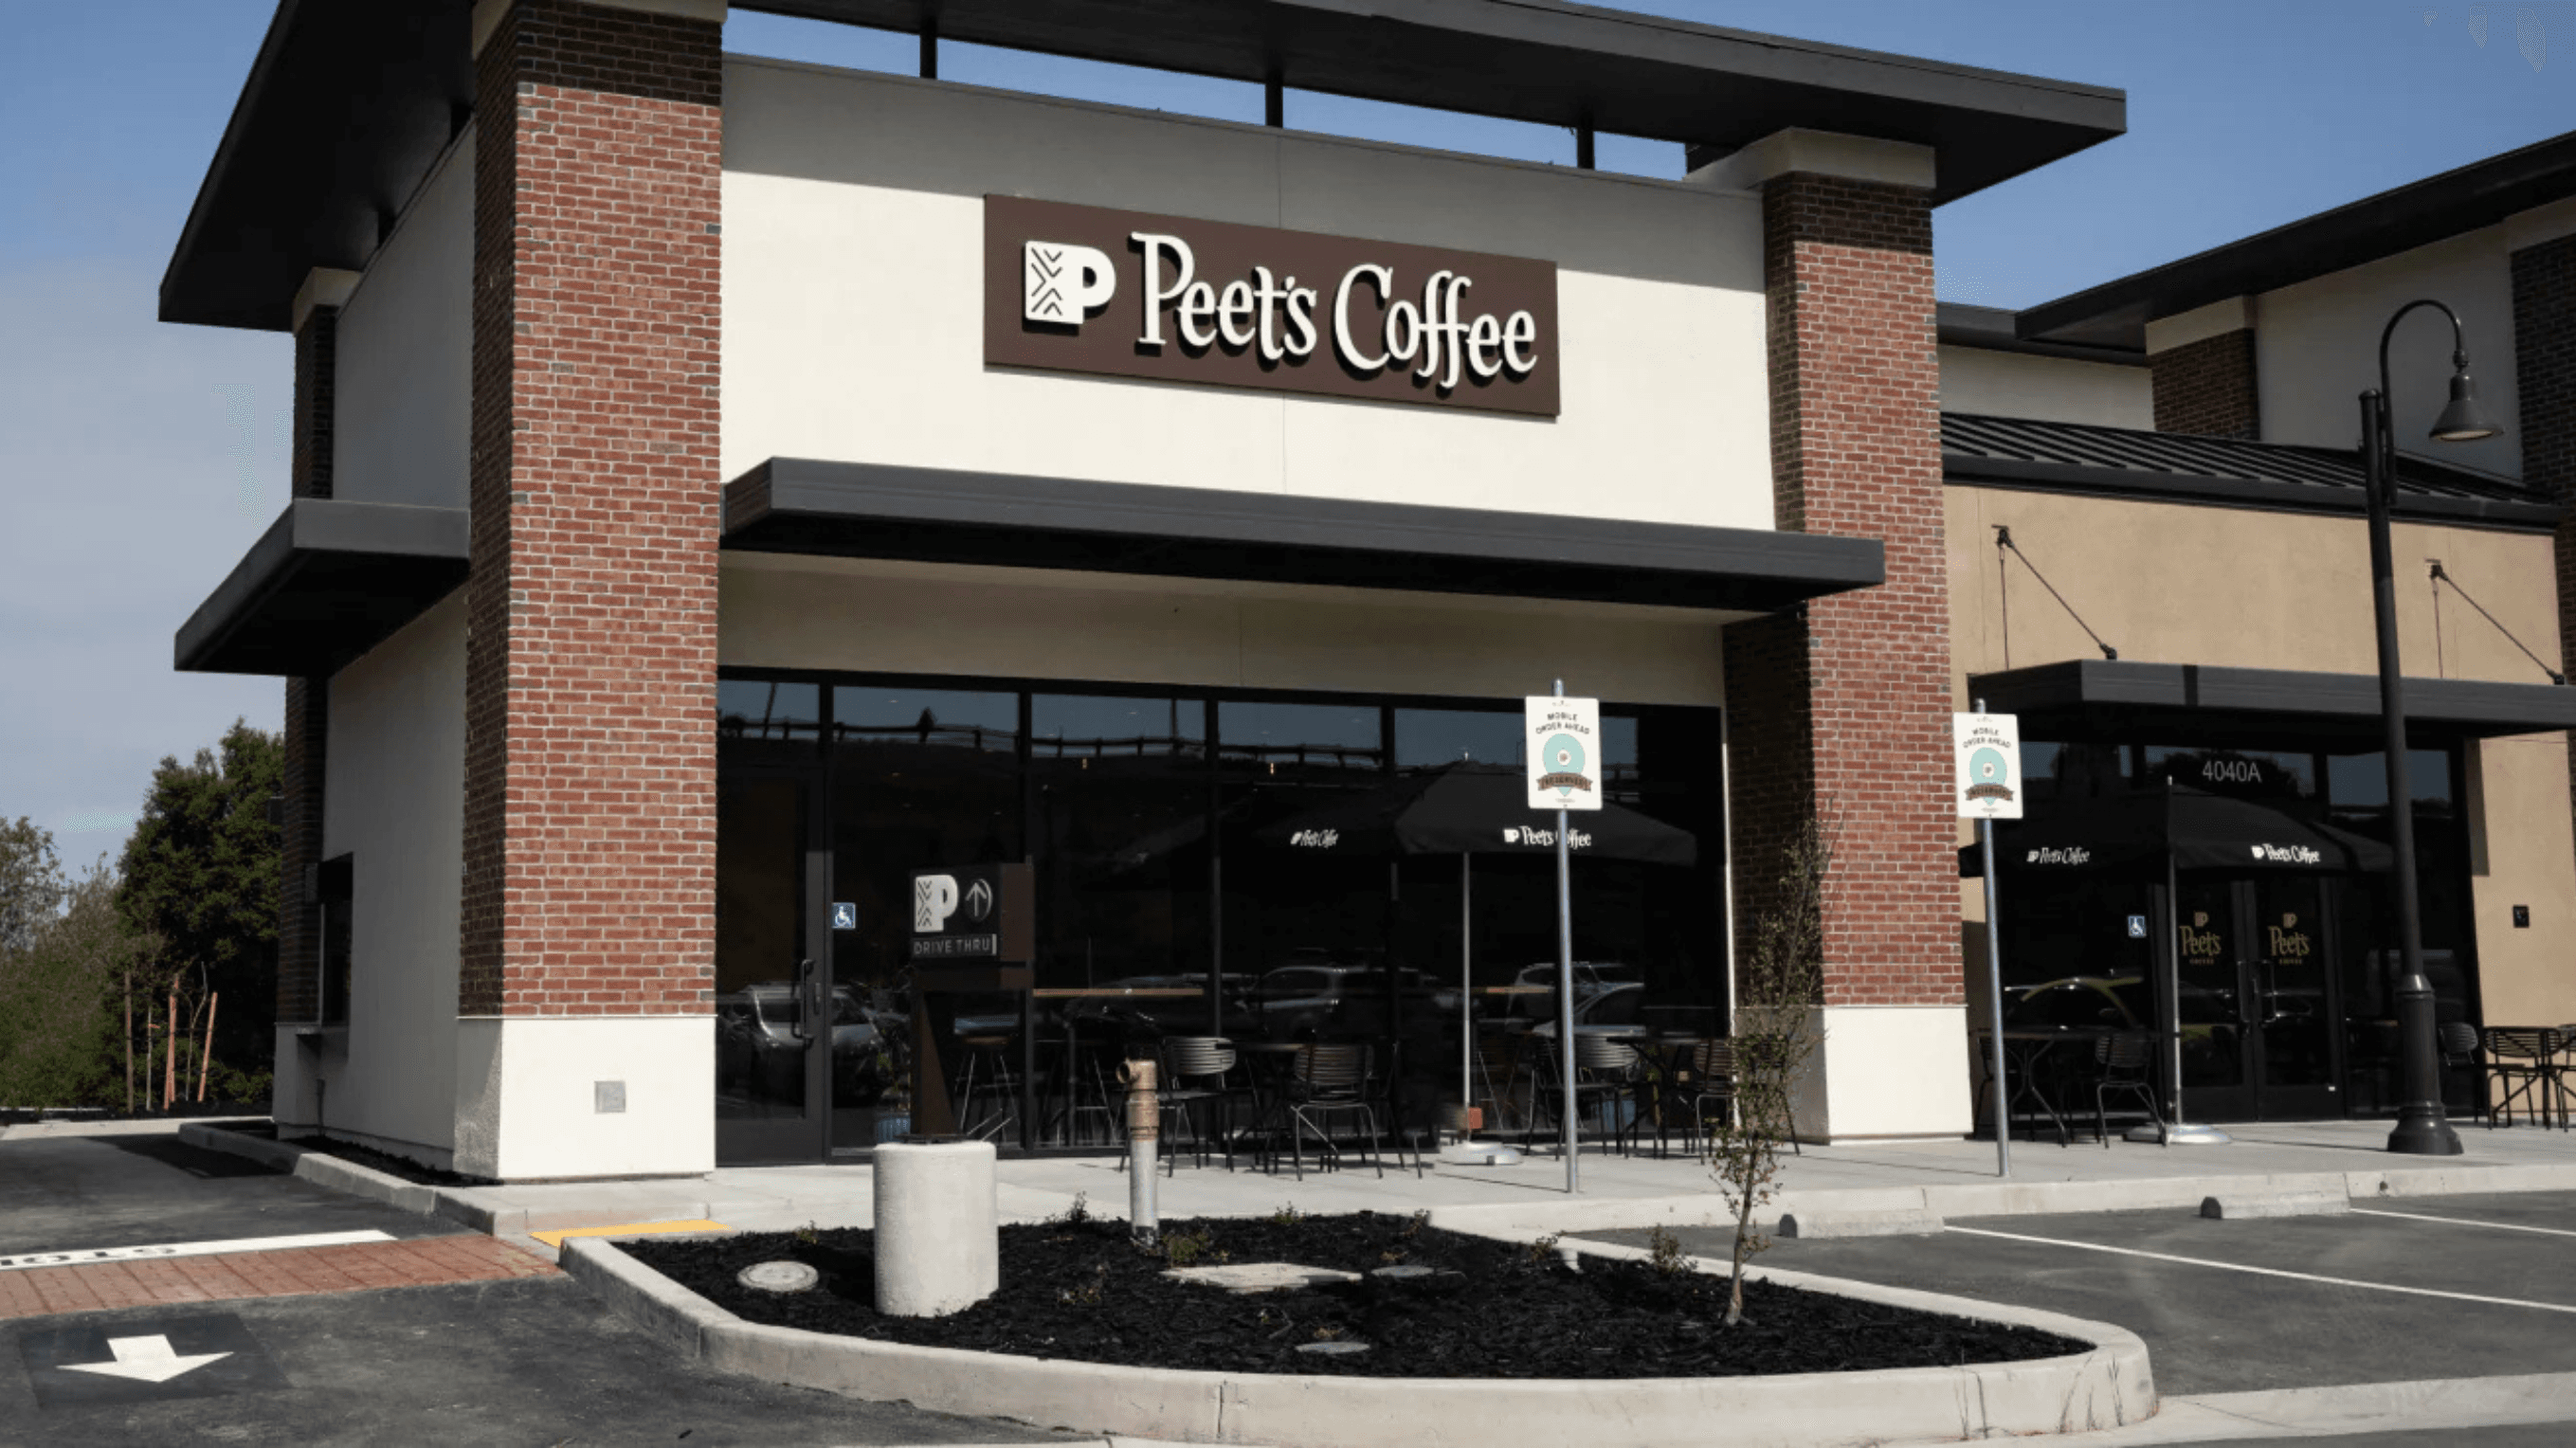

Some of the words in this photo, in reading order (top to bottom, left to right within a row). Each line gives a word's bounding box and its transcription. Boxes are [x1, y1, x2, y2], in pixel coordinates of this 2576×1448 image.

[1130, 231, 1317, 360] Peet's
[1333, 263, 1537, 389] Coffee
[1547, 712, 1578, 721] MOBILE
[1535, 721, 1562, 734] ORDER
[1565, 722, 1589, 734] AHEAD
[1971, 727, 2000, 736] MOBILE
[2202, 760, 2263, 784] 4040A
[1555, 827, 1592, 851] ffee
[914, 939, 952, 955] DRIVE
[956, 938, 990, 952] THRU
